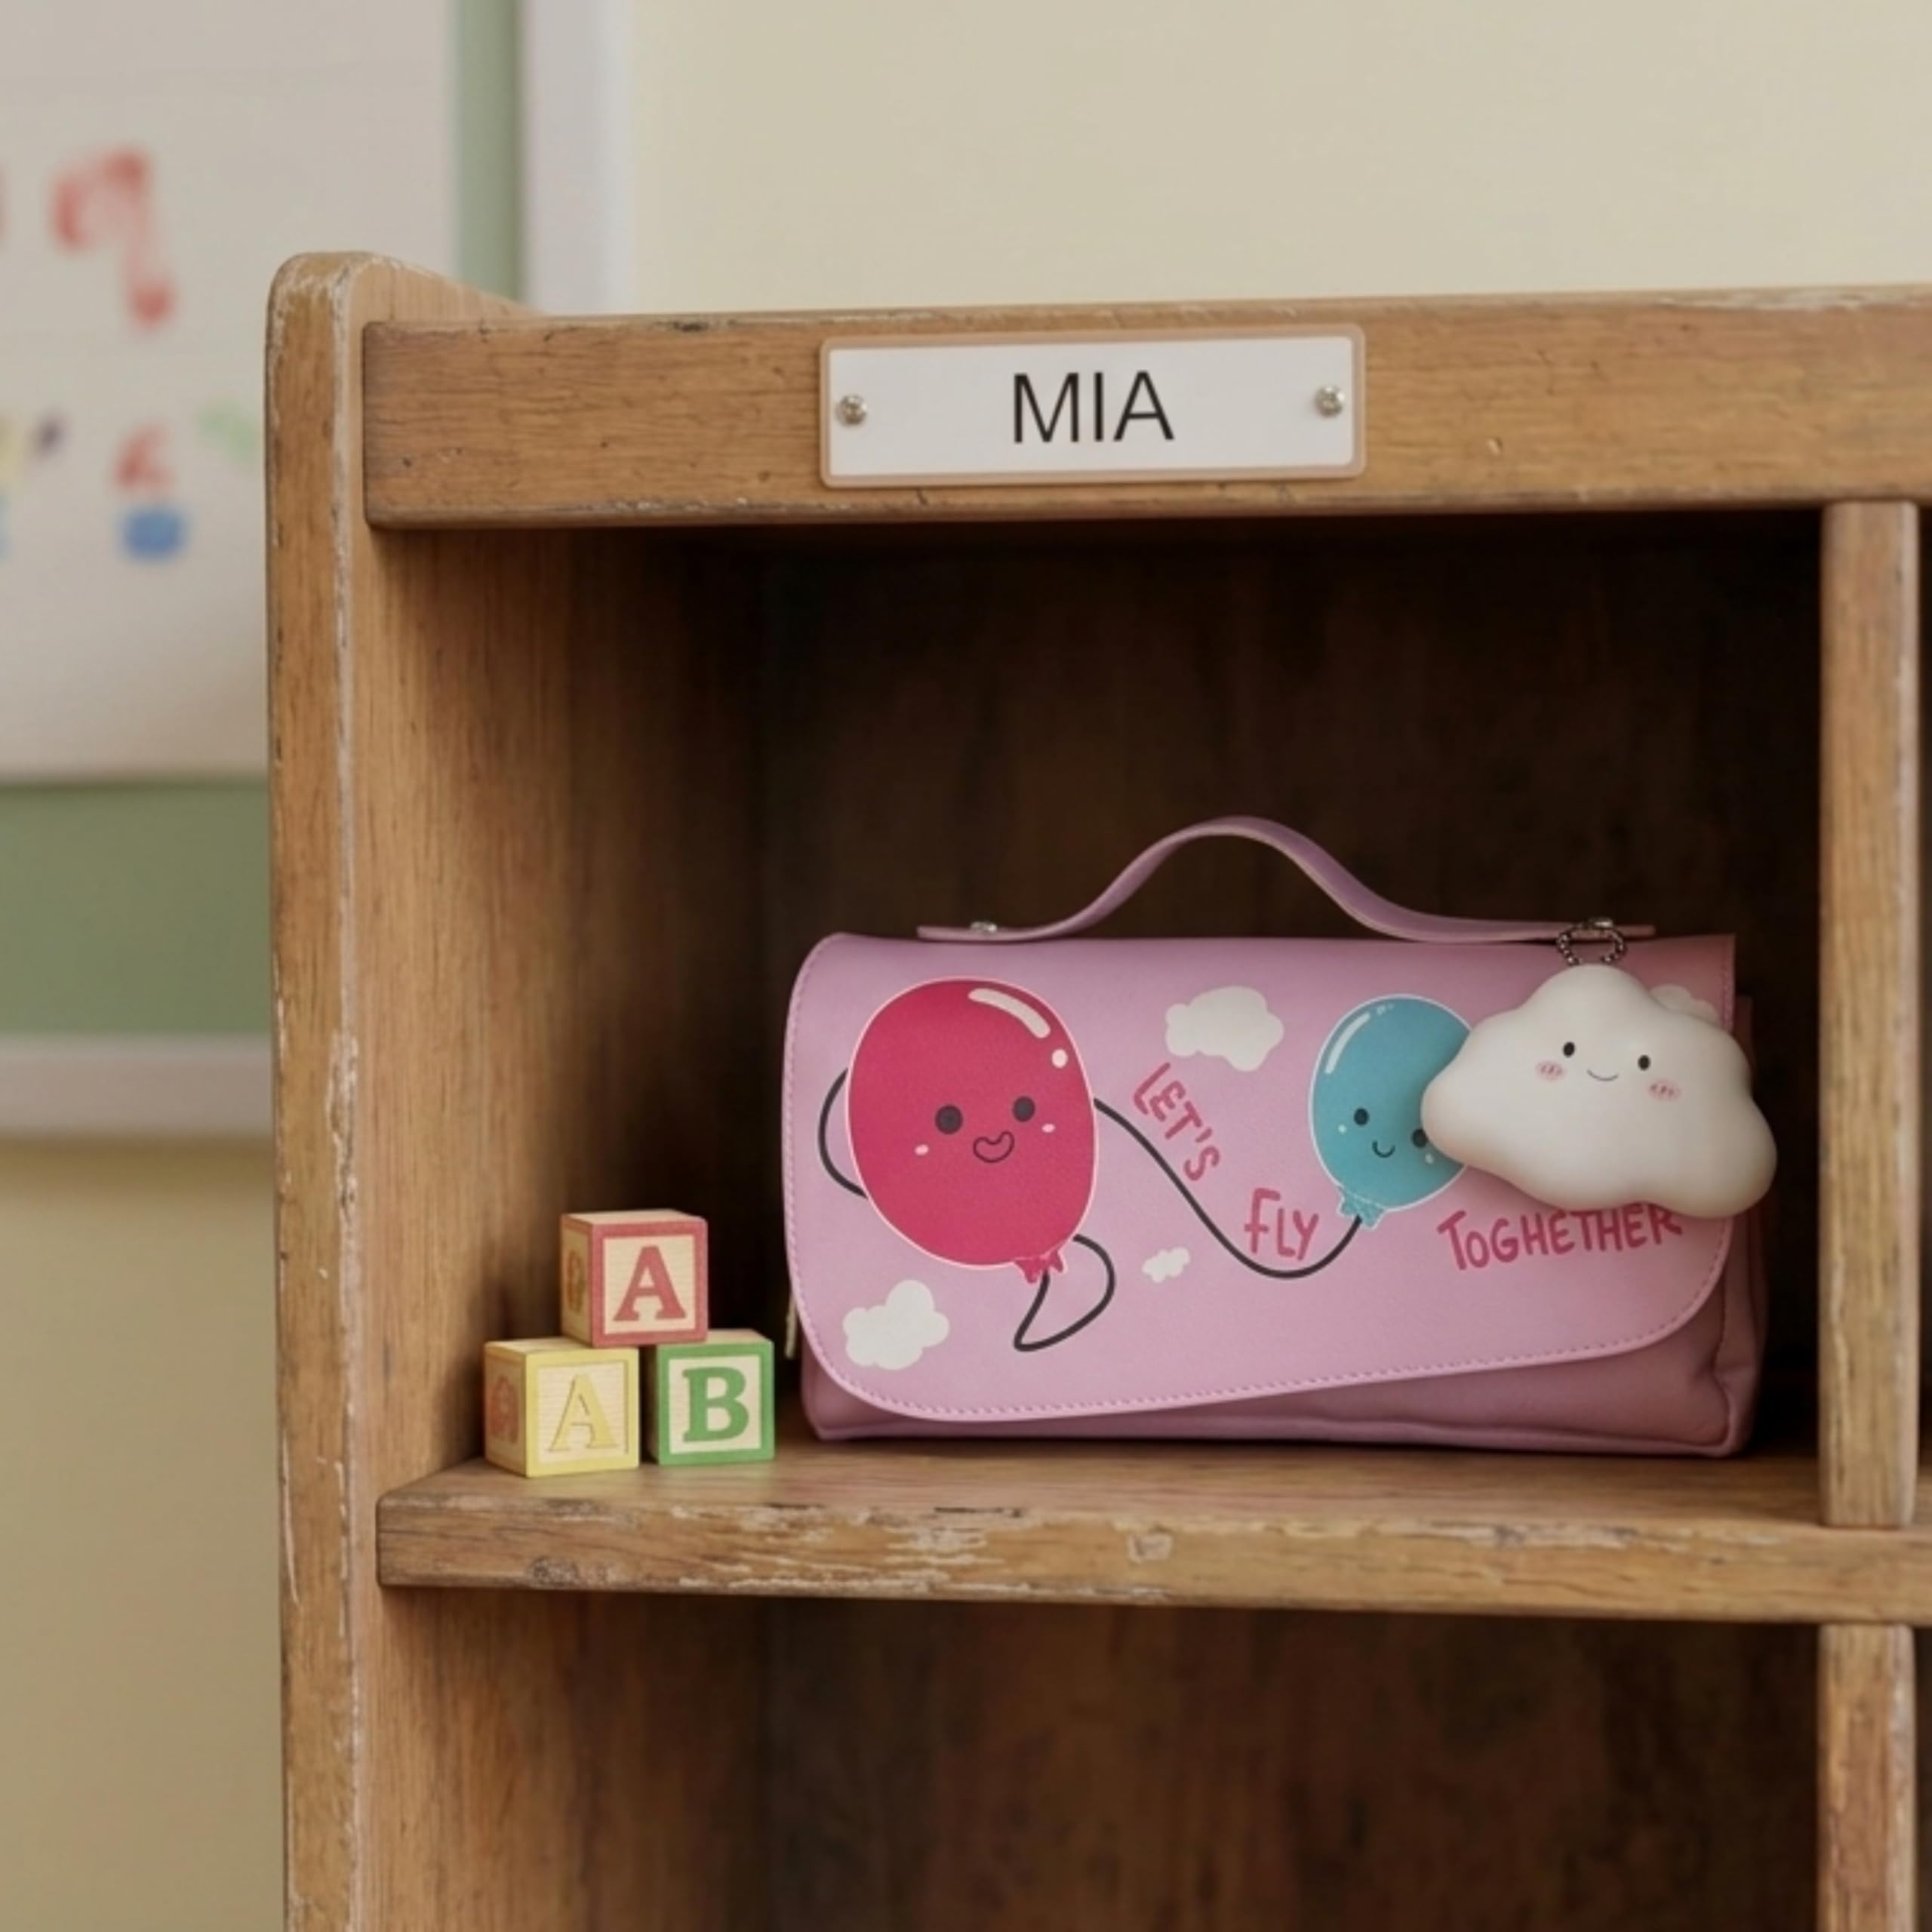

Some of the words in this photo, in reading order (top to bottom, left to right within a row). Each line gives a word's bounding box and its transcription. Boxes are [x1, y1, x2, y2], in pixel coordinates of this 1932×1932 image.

[1013, 370, 1174, 444] MIA
[1133, 1061, 1220, 1182] LET'S
[1244, 1187, 1319, 1261] FLY
[1436, 1201, 1683, 1271] TOGHETHER
[612, 1244, 688, 1322] A
[545, 1372, 620, 1453] A
[681, 1366, 749, 1443] B
